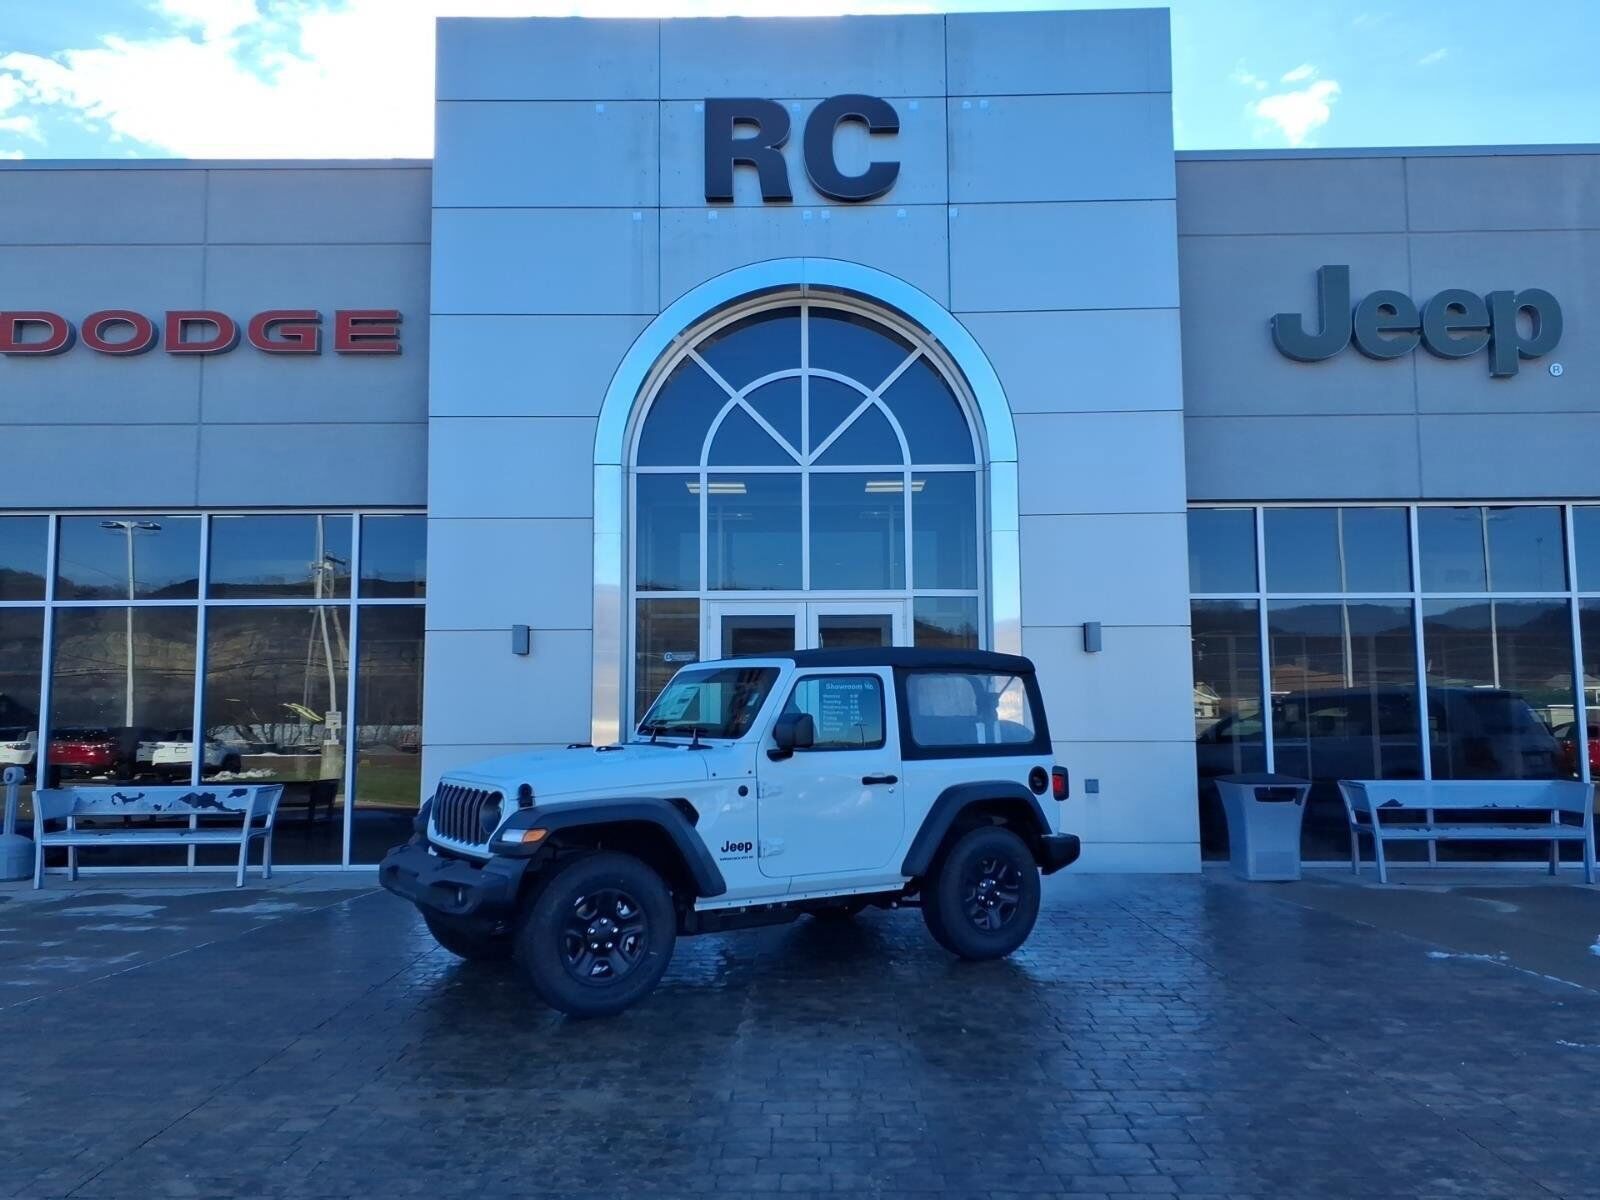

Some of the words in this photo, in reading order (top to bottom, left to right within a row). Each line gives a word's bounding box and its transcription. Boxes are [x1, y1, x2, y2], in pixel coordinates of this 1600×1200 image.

[704, 94, 900, 205] RC
[0, 309, 402, 356] DODGE
[1271, 264, 1563, 379] Jeep
[720, 840, 753, 853] Jeep
